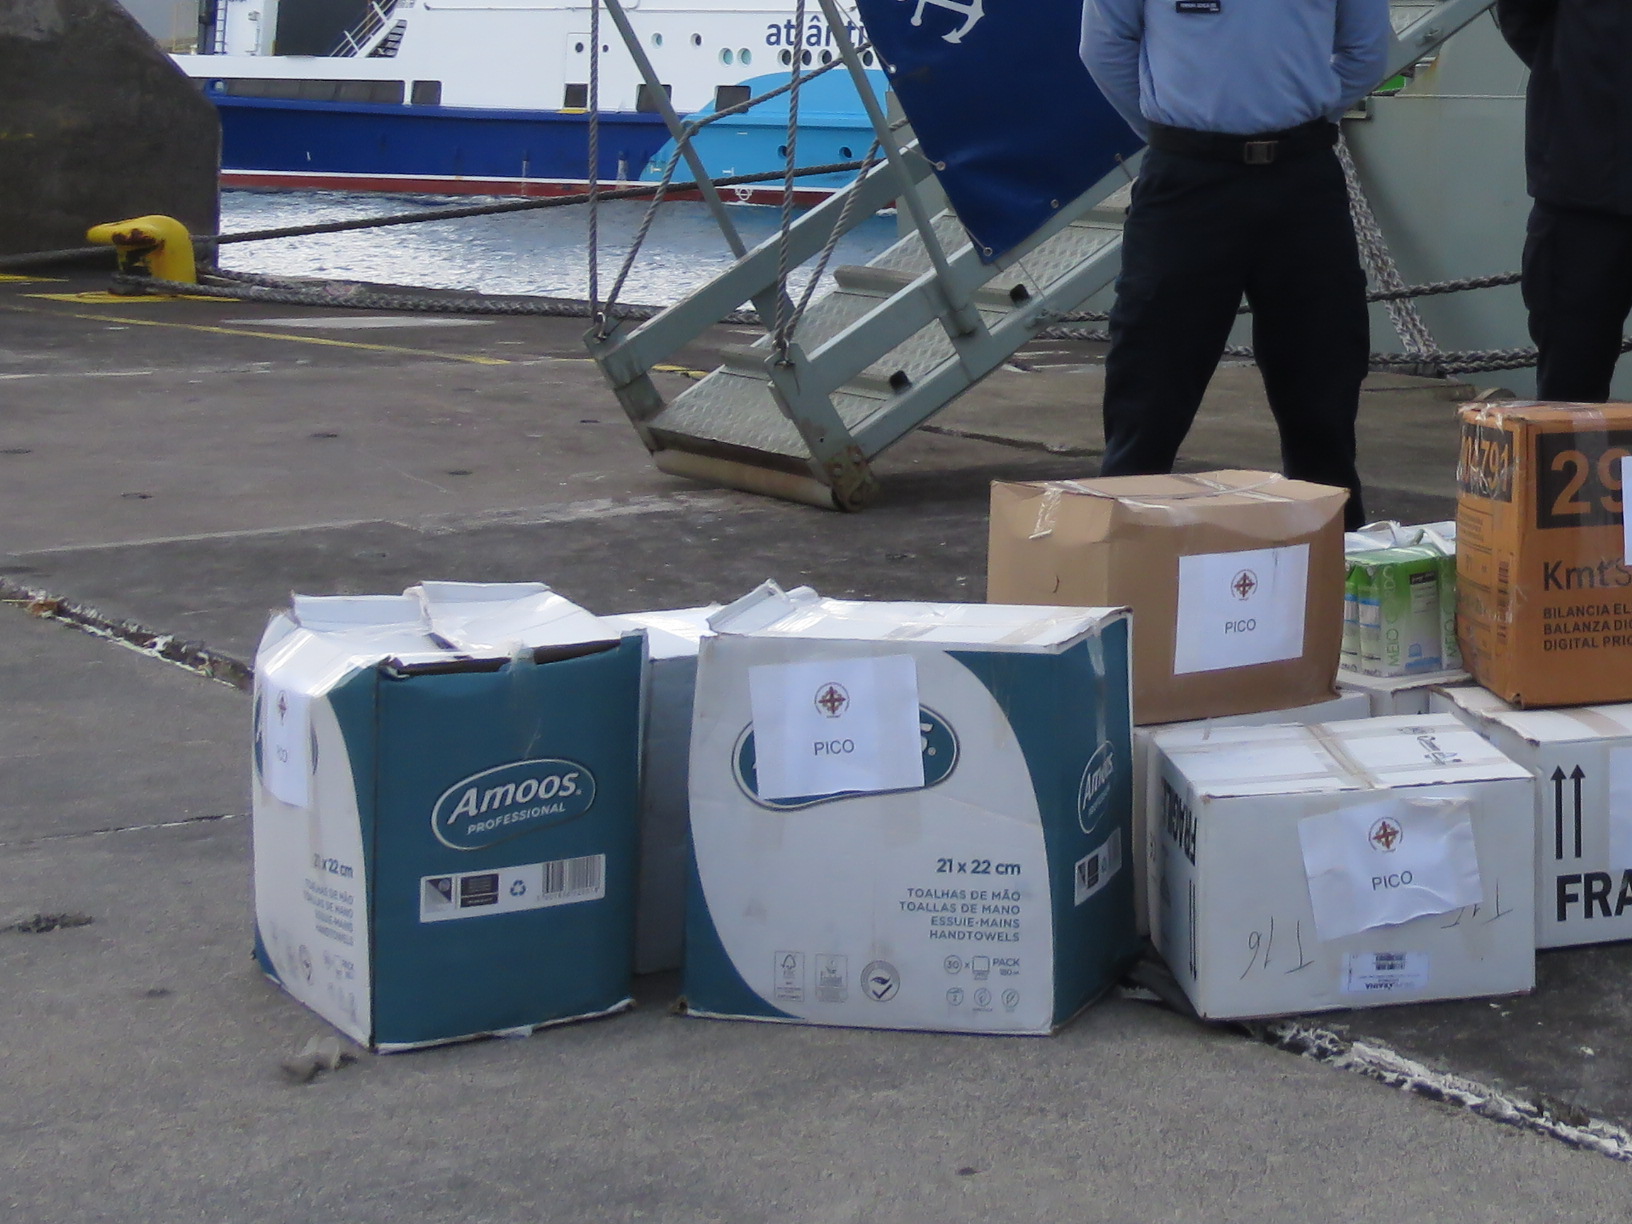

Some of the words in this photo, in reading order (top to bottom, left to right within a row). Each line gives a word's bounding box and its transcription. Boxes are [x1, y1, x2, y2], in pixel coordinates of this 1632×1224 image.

[1543, 604, 1610, 619] BILANCIA
[1225, 618, 1257, 634] PICO
[1543, 620, 1611, 635] BALANZA
[1543, 636, 1599, 651] DIGITAL
[814, 739, 855, 755] PICO
[447, 772, 580, 825] Amoos
[467, 802, 566, 835] PROFESSIONAL
[936, 858, 953, 873] 21
[957, 862, 967, 873] x
[971, 859, 991, 874] 22
[995, 863, 1021, 875] cm
[1371, 870, 1413, 891] PICO
[907, 888, 967, 900] TOALHAS
[970, 890, 988, 901] DE
[991, 889, 1021, 902] MÃO
[899, 901, 957, 913] TOALLAS
[961, 903, 978, 914] DE
[981, 904, 1020, 915] MANO
[931, 916, 1020, 929] ESSUIE-MAINS
[929, 930, 1020, 942] HANDTOWELS
[946, 960, 960, 970] 30
[992, 958, 1020, 967] PACK
